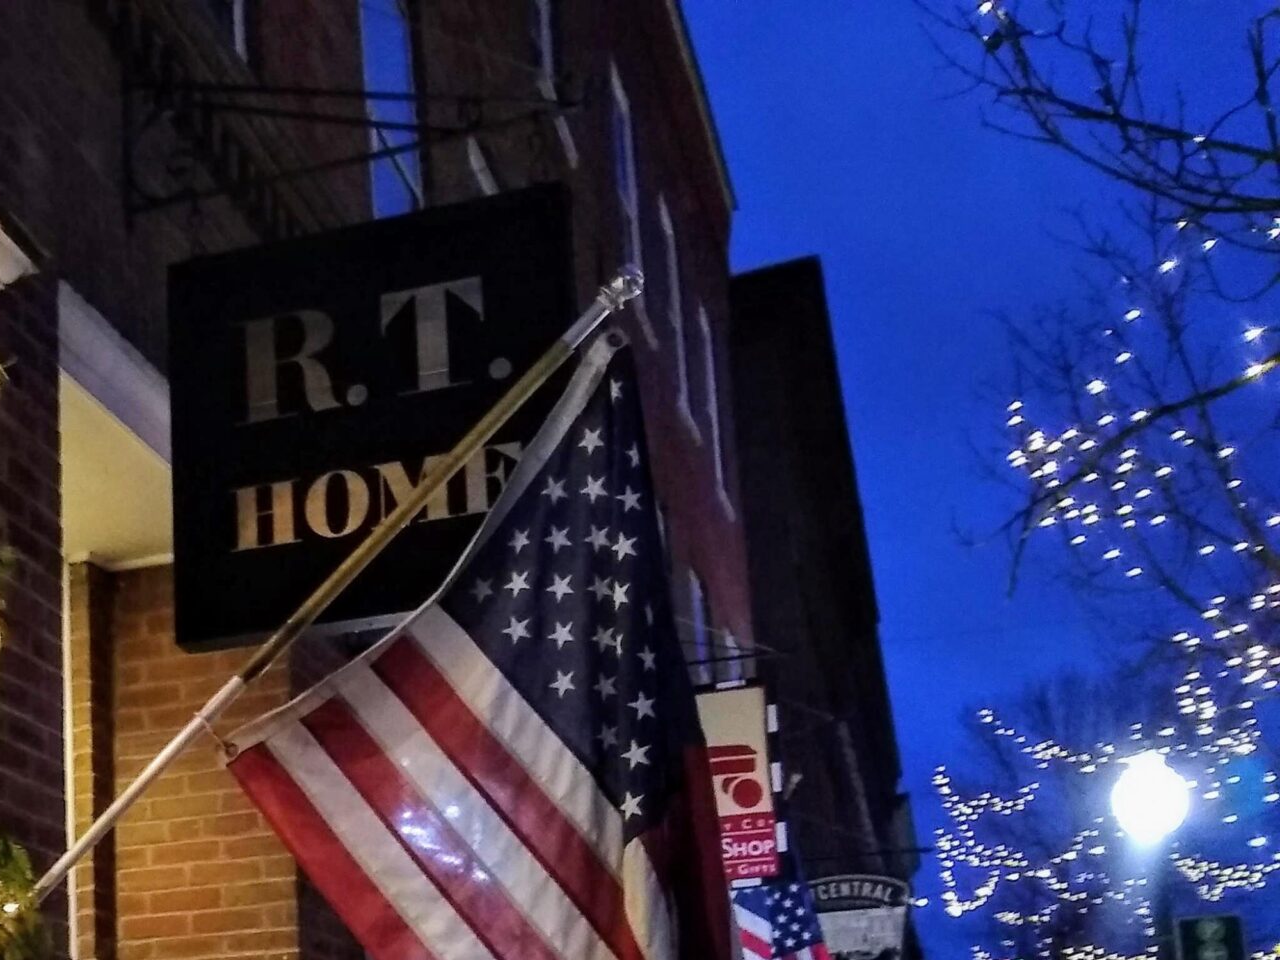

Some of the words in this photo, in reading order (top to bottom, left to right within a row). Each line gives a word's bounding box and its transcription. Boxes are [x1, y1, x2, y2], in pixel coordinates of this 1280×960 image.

[229, 441, 523, 551] HOME
[721, 838, 775, 859] SHOP
[817, 881, 893, 901] CENTRAL
